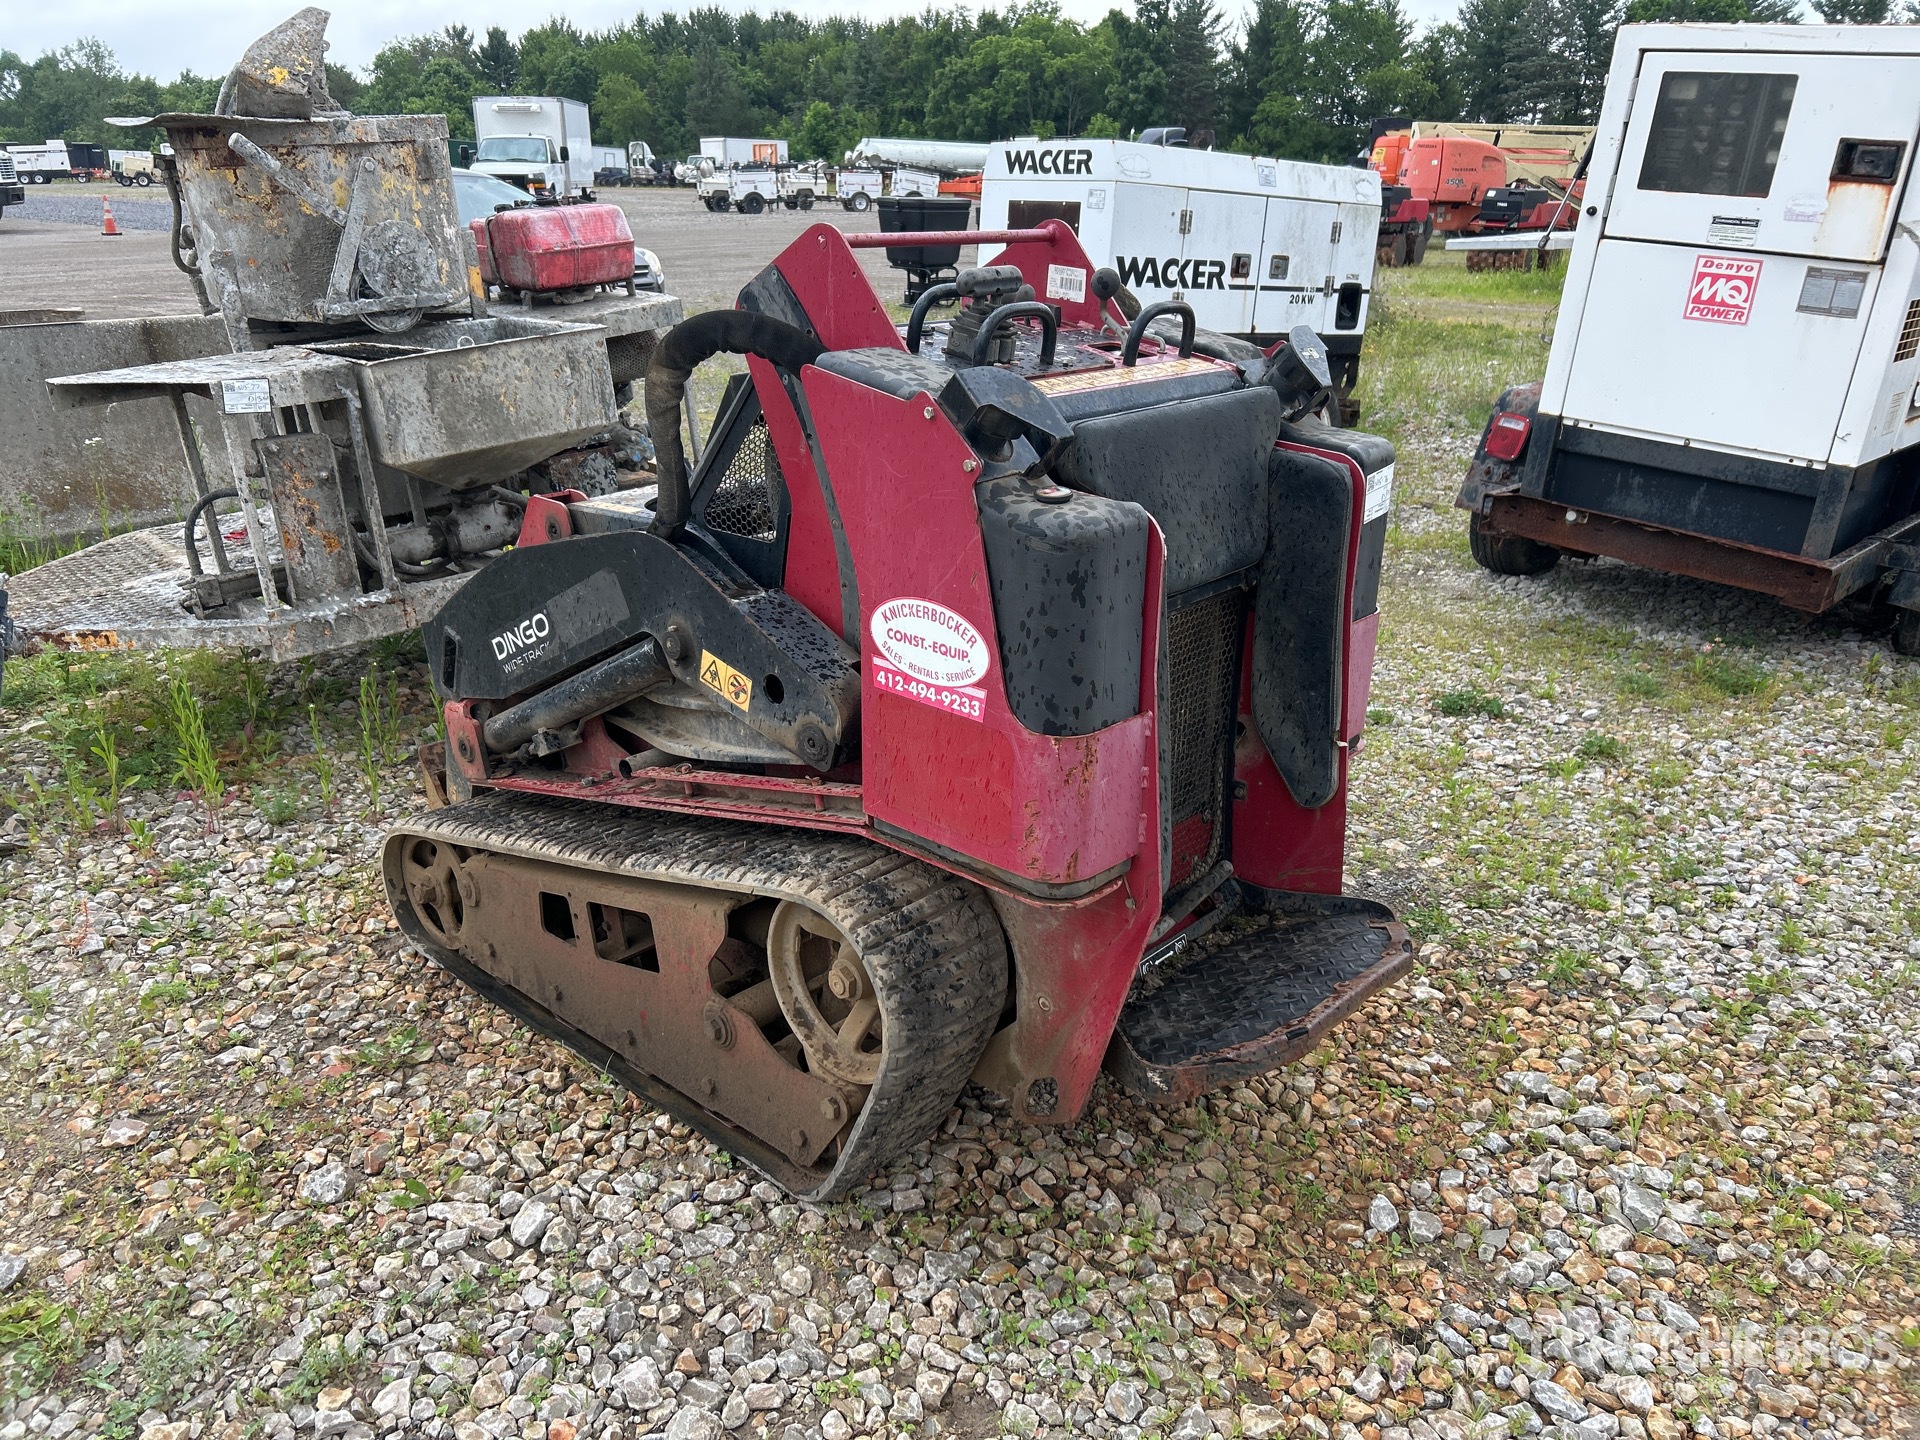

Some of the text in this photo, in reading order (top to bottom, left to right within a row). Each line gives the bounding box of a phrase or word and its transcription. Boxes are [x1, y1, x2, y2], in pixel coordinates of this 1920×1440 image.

[1004, 149, 1093, 175] WACKER
[1115, 255, 1226, 290] WACKER
[1702, 259, 1755, 273] Denyo
[1690, 276, 1749, 309] MQ
[1688, 305, 1746, 321] POWER
[491, 612, 550, 661] DINGO
[881, 603, 978, 650] KNICKERBOCKER
[881, 640, 903, 665] SALES
[908, 661, 940, 682] RENTALS
[945, 666, 977, 683] SERVICE
[886, 627, 972, 664] CONST.-EQUIP.
[876, 670, 981, 717] 412-494-9233
